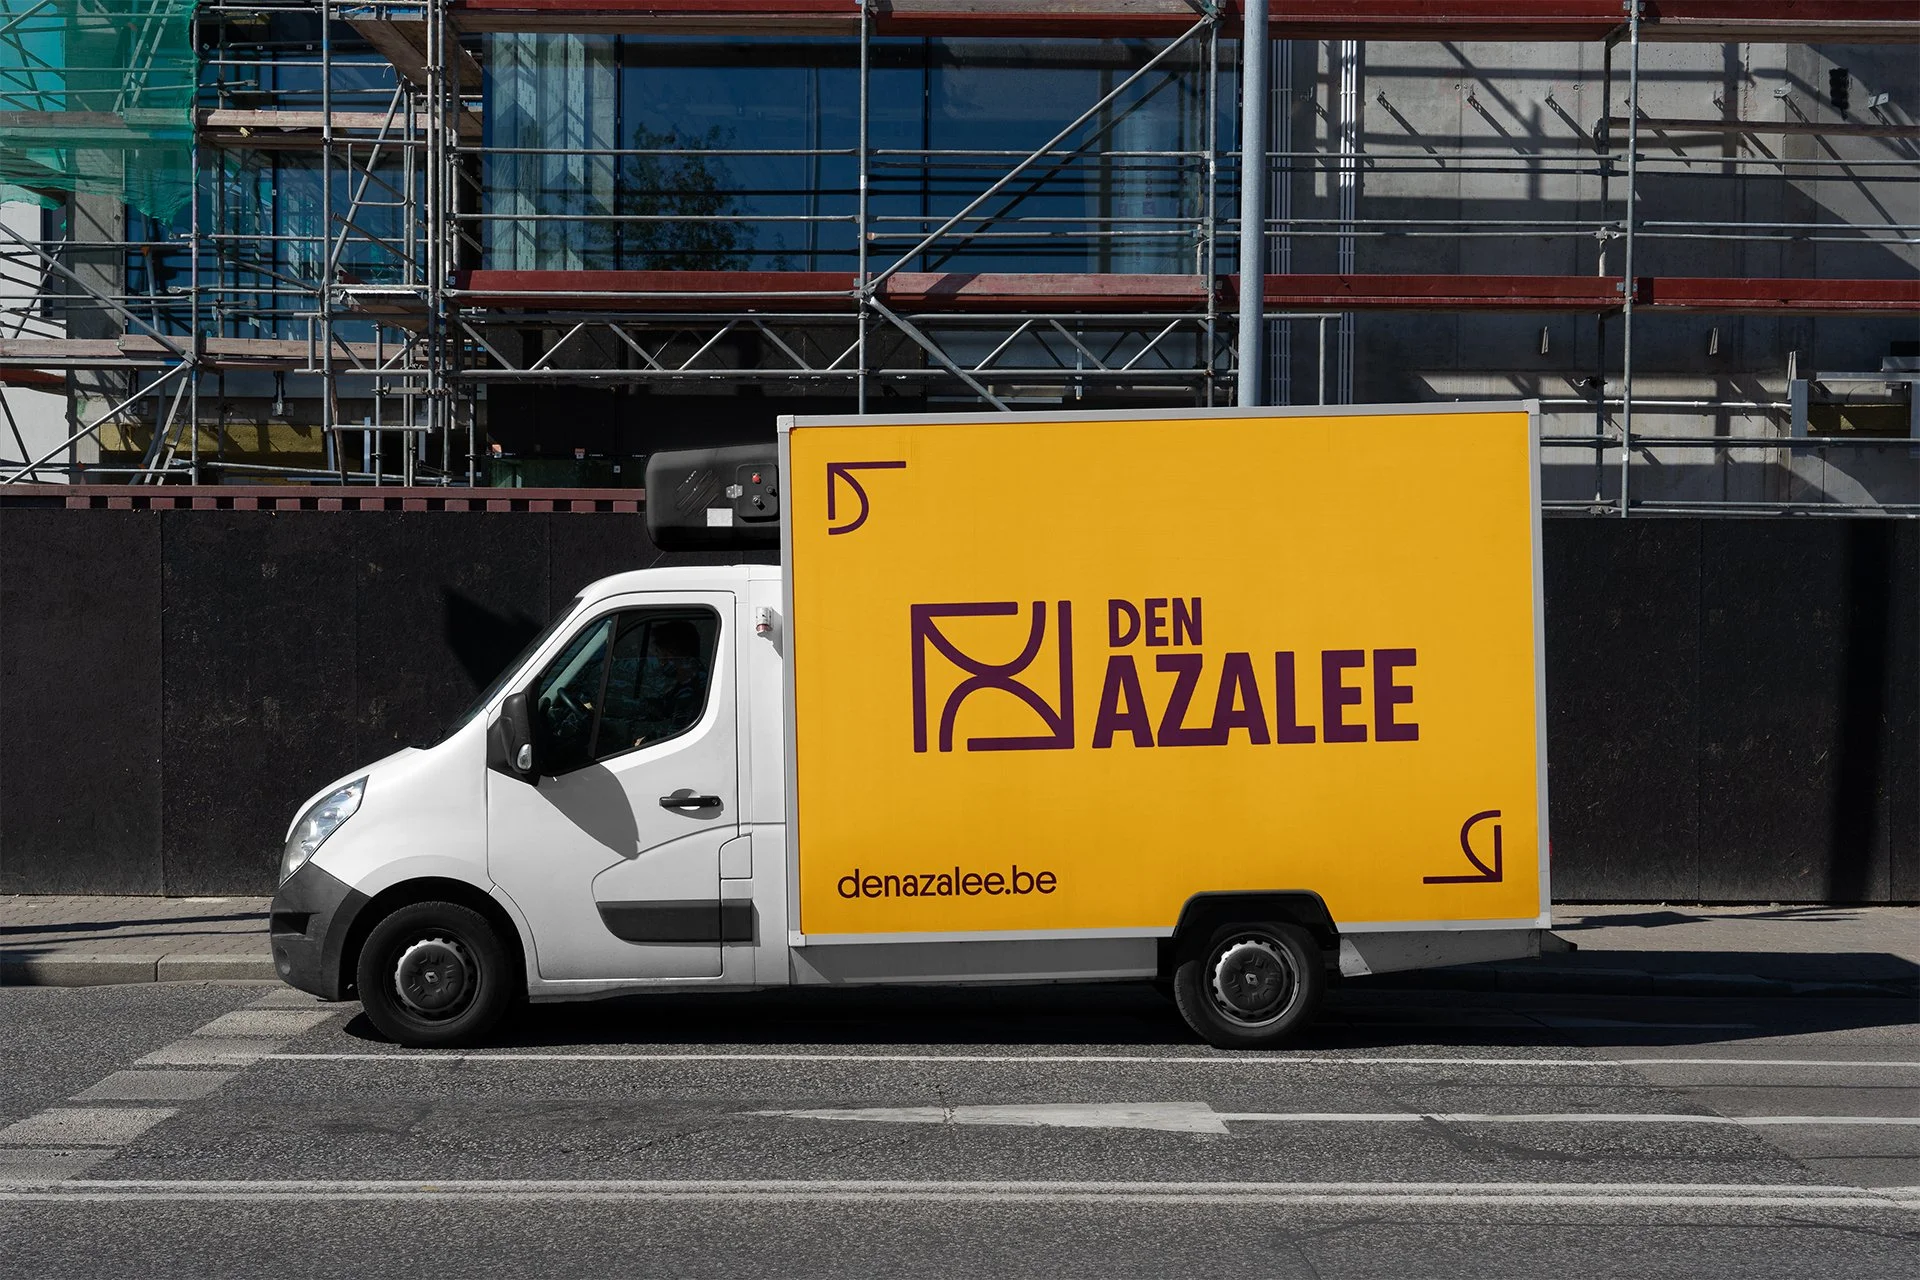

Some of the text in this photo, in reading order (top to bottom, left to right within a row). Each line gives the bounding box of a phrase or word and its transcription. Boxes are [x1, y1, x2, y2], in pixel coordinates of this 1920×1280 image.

[1108, 597, 1203, 648] DEN
[1092, 648, 1420, 749] AZALEE
[838, 865, 1057, 899] denazalee.be
